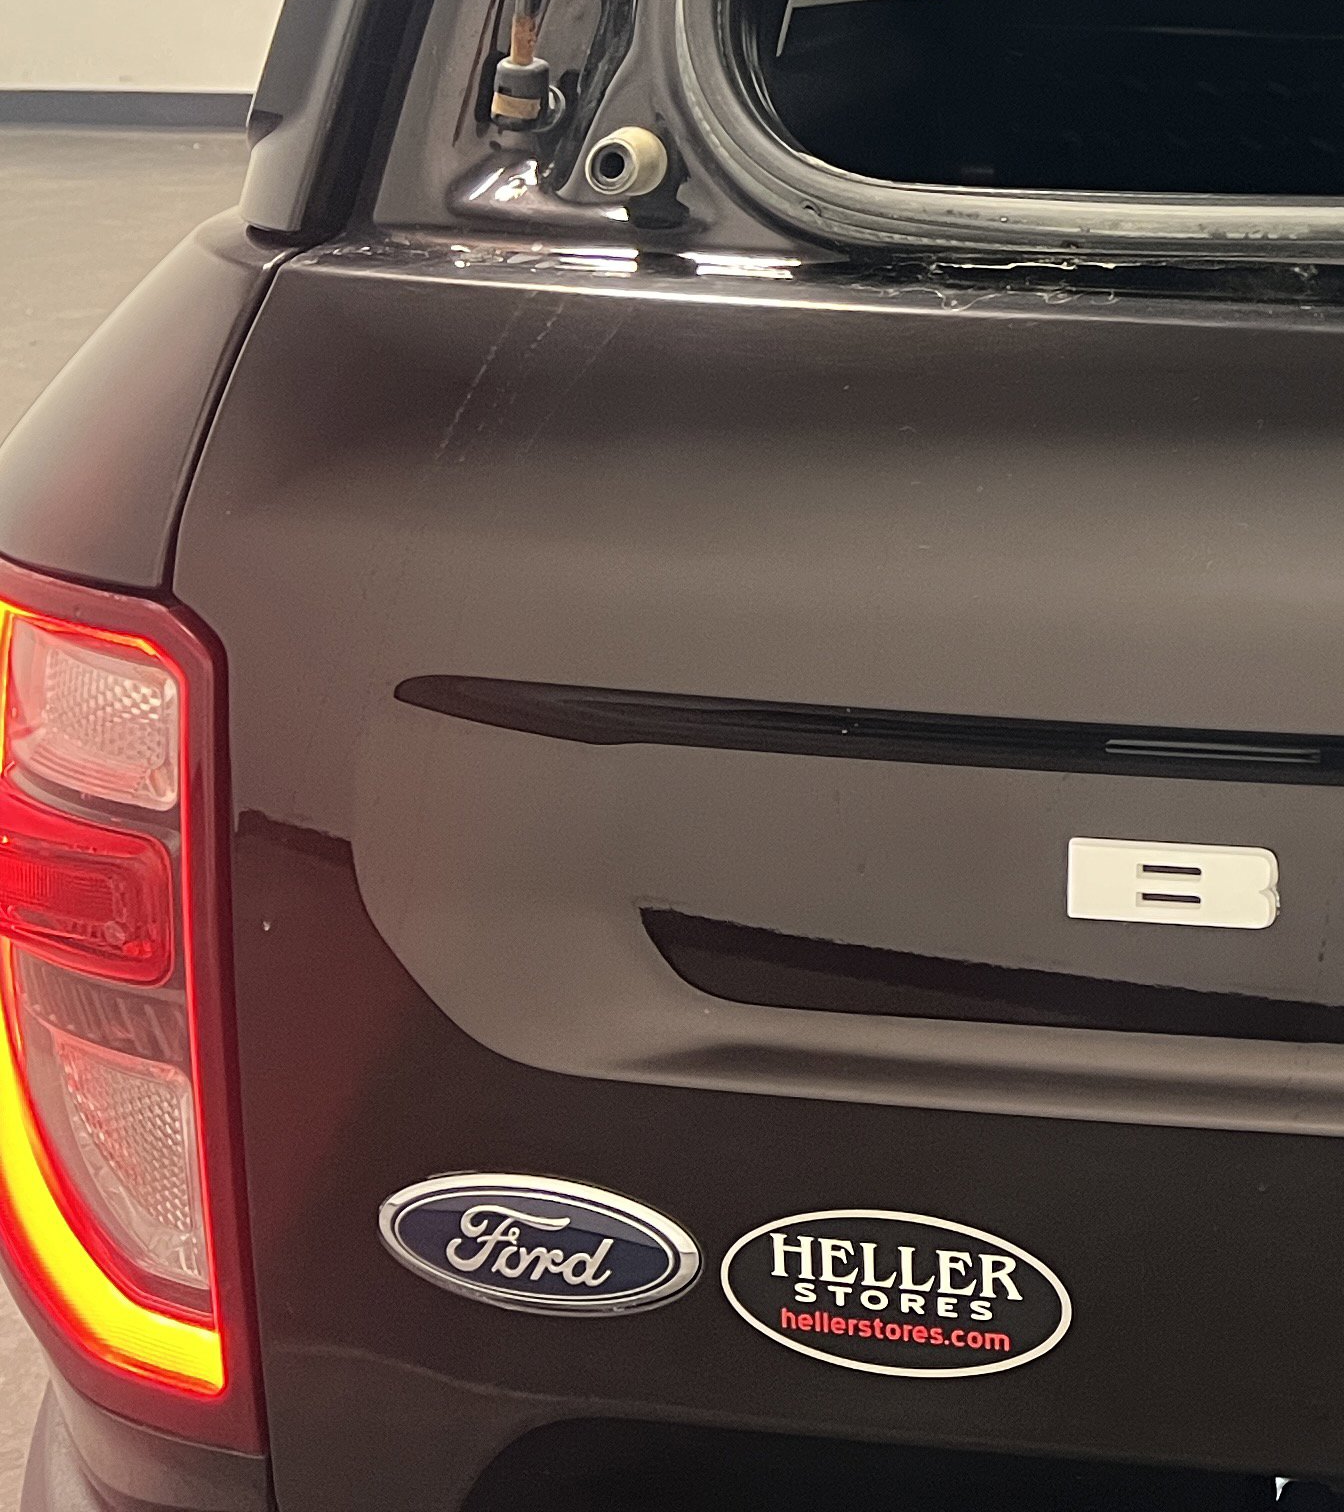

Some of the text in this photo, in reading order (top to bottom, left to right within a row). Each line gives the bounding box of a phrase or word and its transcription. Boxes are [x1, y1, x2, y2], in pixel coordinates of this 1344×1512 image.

[445, 1204, 613, 1288] Ford
[769, 1232, 1023, 1301] HELLER
[793, 1281, 994, 1322] STORES
[781, 1308, 1011, 1353] hellerstores.com
